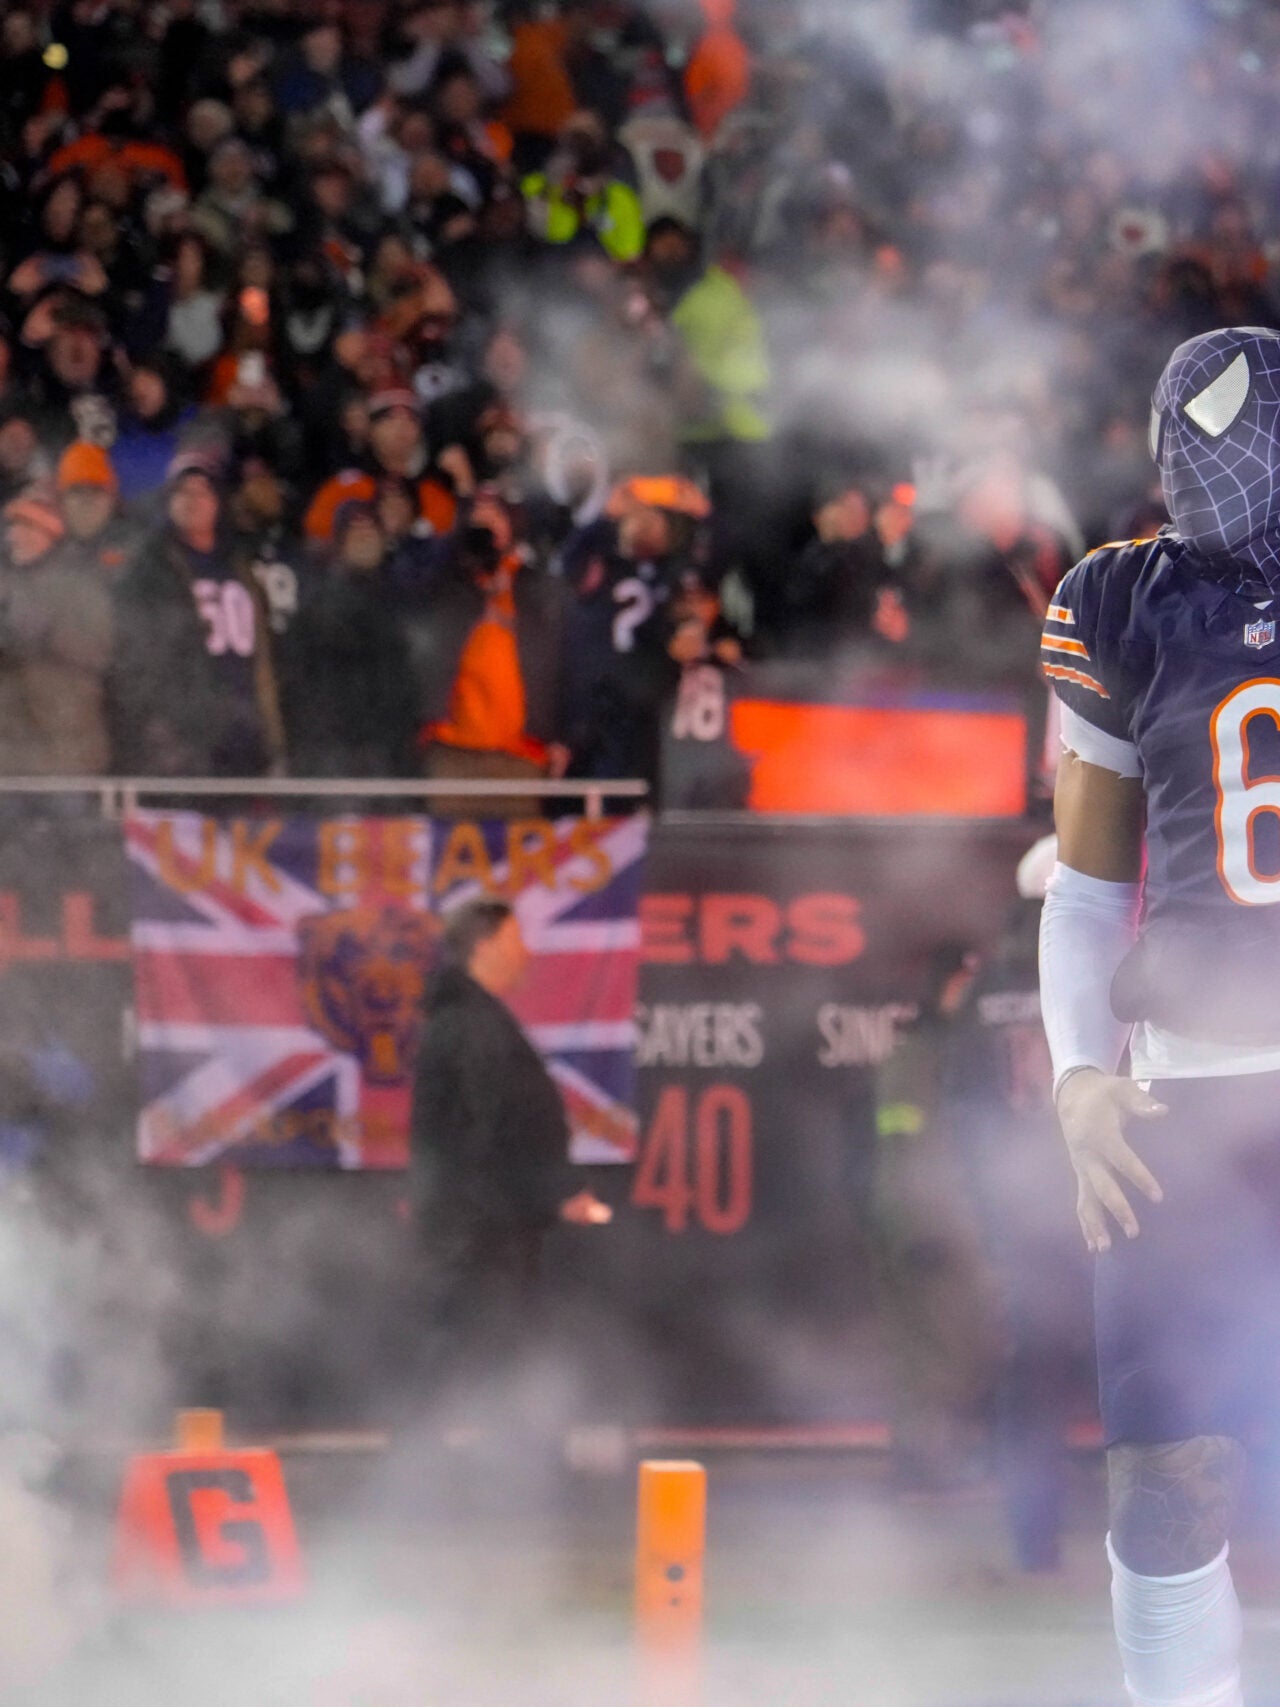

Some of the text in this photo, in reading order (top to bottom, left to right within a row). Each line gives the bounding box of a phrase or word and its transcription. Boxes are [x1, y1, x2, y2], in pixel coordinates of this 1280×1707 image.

[155, 815, 615, 898] UK BEARS
[632, 1083, 754, 1235] 40
[165, 1467, 274, 1586] G
